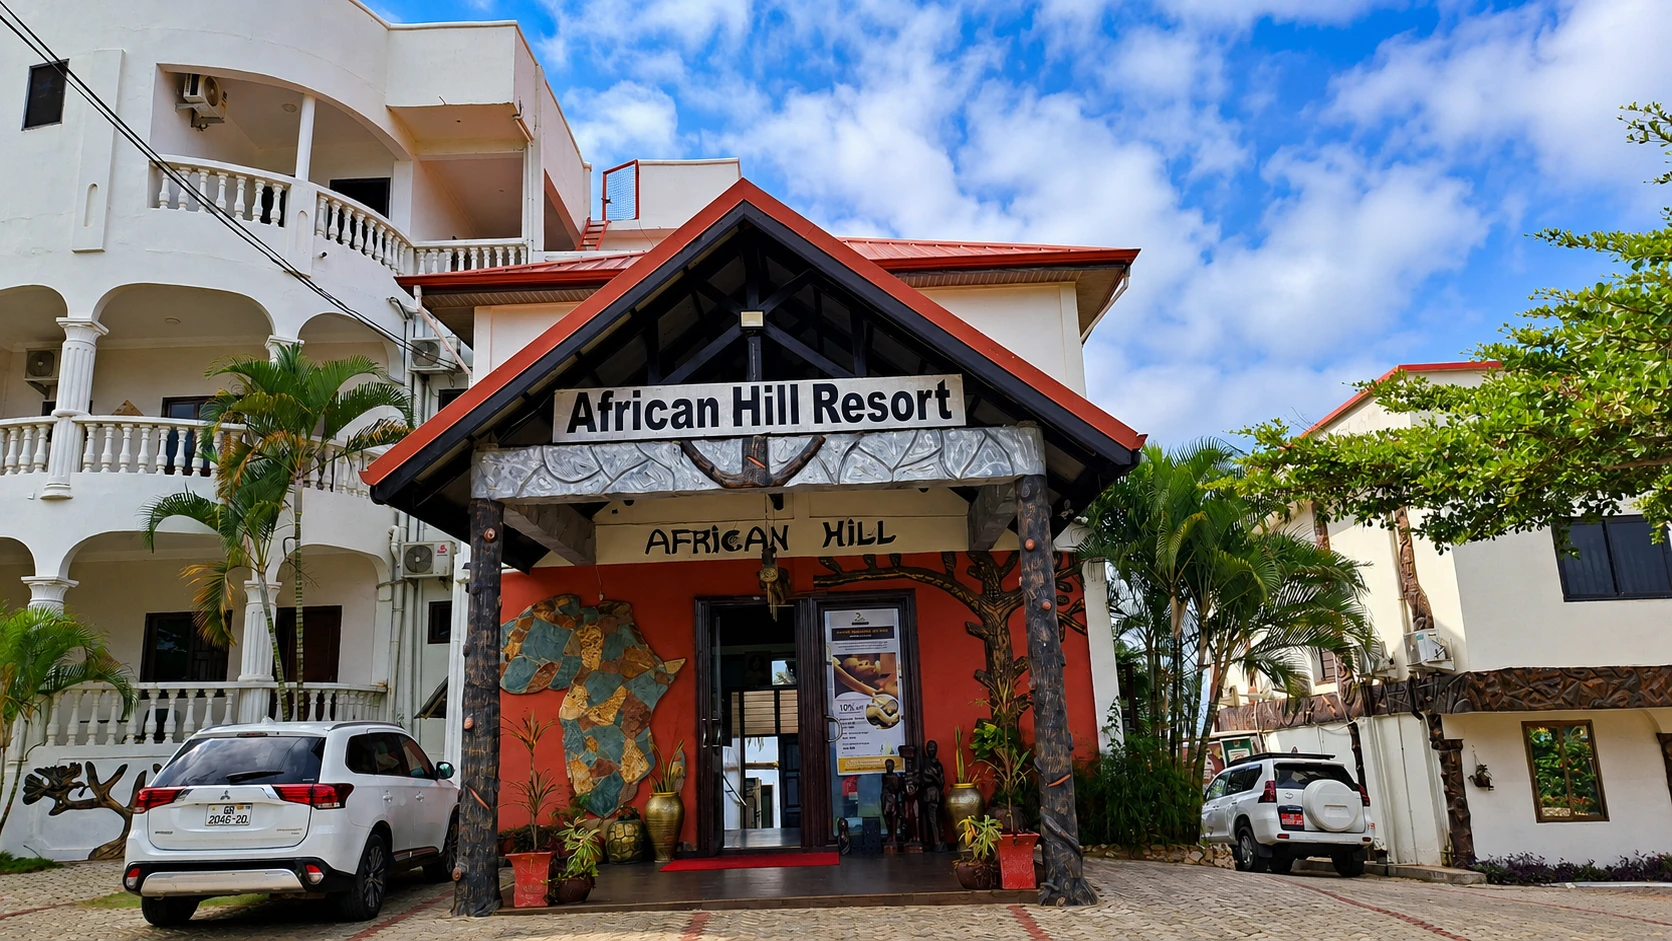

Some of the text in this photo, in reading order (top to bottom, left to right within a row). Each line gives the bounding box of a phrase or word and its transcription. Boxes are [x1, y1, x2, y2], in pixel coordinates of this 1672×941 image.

[565, 378, 953, 434] African Hill Resort
